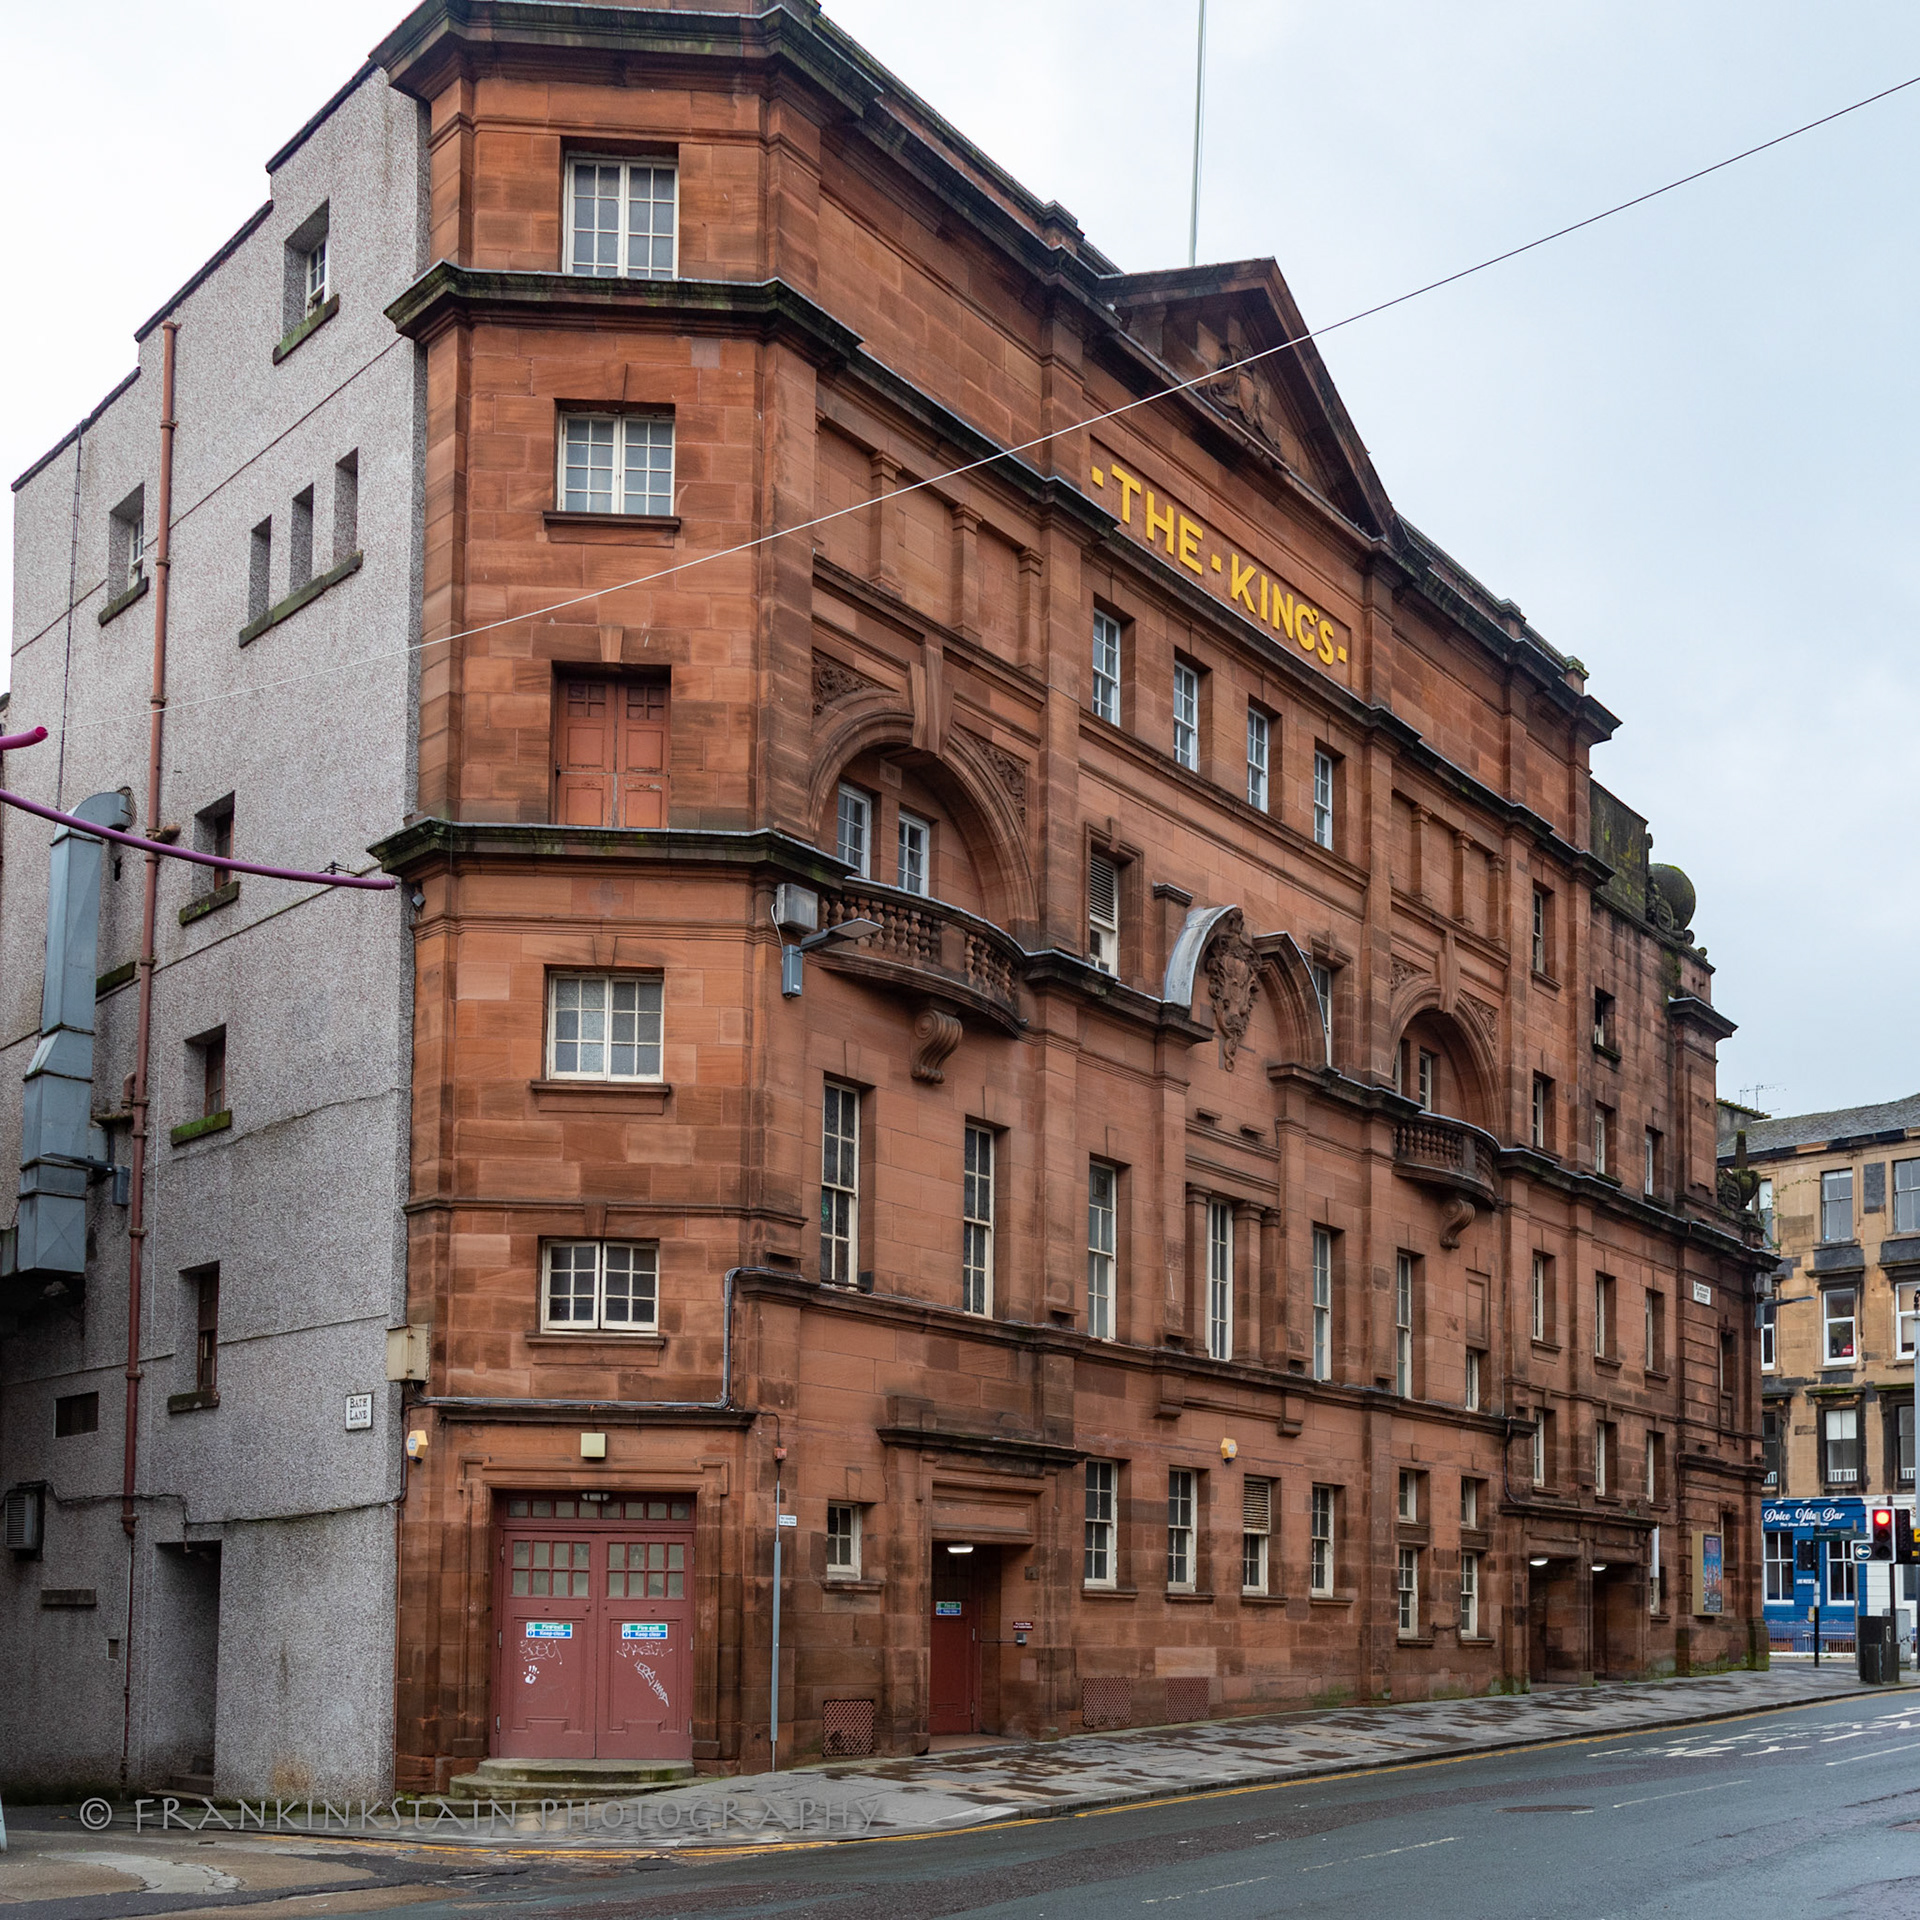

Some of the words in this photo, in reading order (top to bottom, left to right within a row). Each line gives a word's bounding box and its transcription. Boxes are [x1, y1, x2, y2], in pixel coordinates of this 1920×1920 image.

[1111, 463, 1204, 576] THE
[1231, 552, 1335, 666] KING'S
[350, 1398, 368, 1408] BATH
[350, 1410, 368, 1420] LANE
[1764, 1508, 1791, 1522] Dolce
[1795, 1508, 1816, 1523] Vita
[1822, 1507, 1845, 1521] Bar
